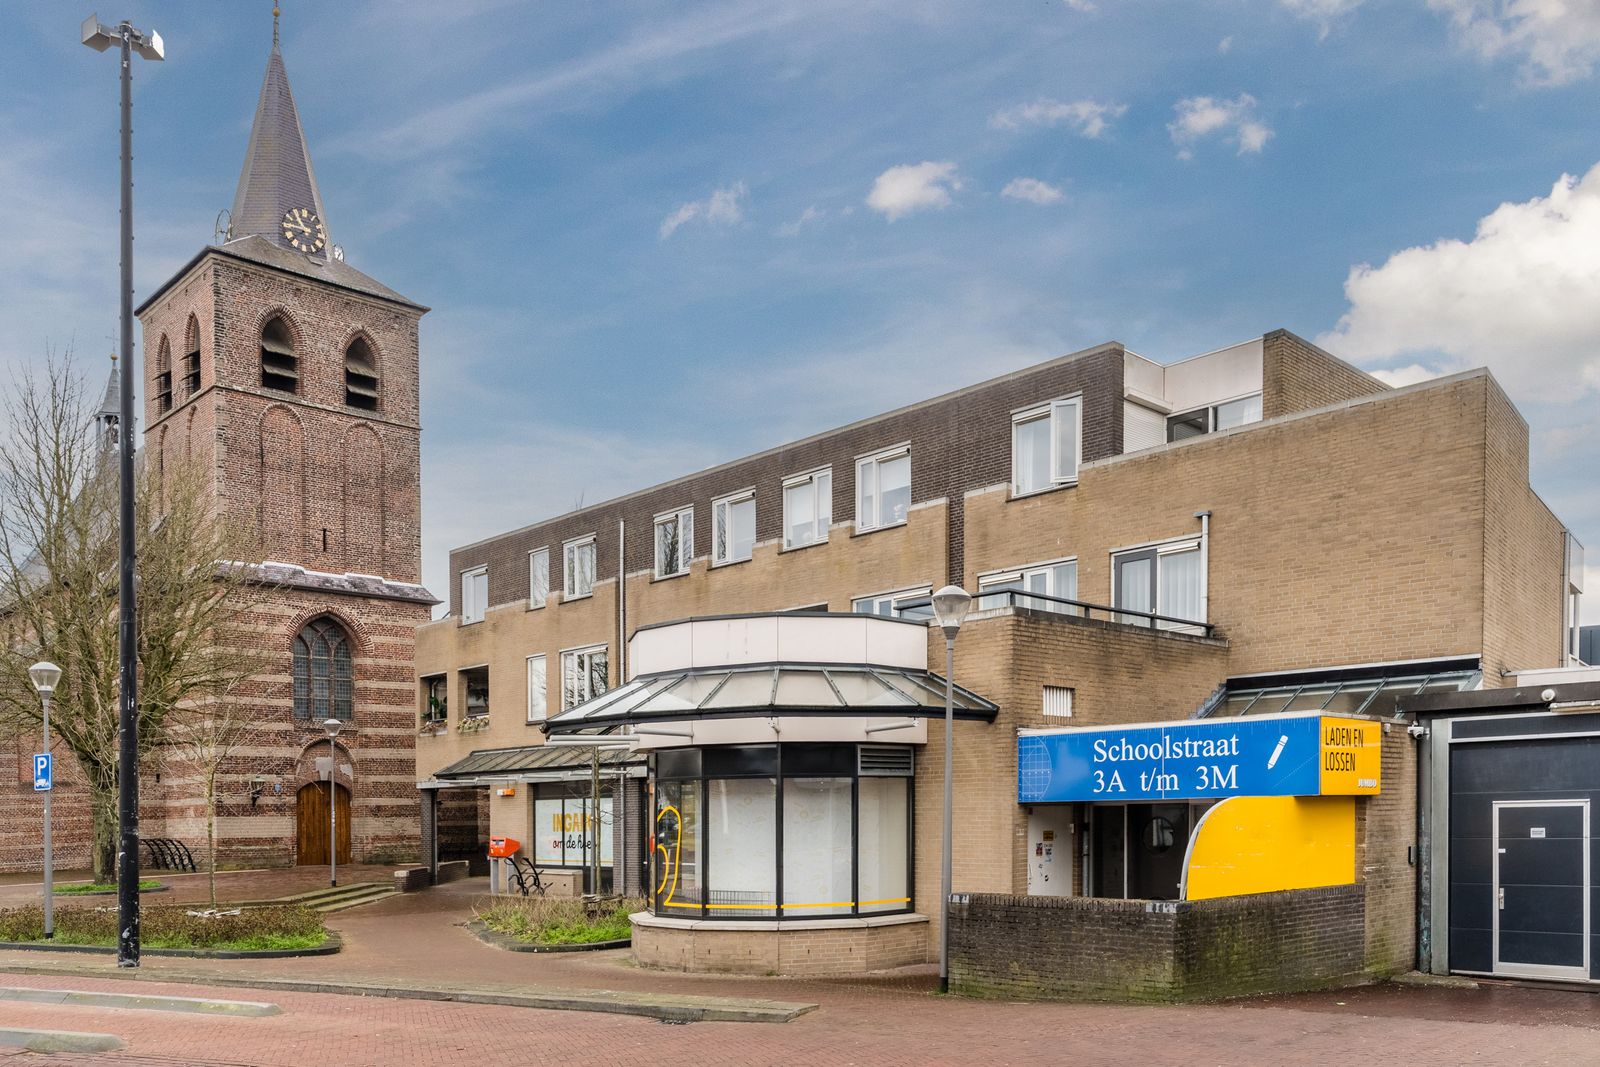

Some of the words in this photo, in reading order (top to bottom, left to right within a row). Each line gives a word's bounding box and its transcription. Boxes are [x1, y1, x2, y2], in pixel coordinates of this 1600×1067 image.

[1325, 726, 1352, 747] LADEN
[1354, 728, 1364, 748] EN
[1093, 734, 1240, 763] Schoolstraat
[37, 757, 47, 776] P
[1325, 752, 1356, 772] LOSSEN
[1093, 769, 1127, 793] 3A
[1139, 767, 1180, 792] t/m
[1195, 764, 1240, 790] 3M
[566, 834, 577, 849] de
